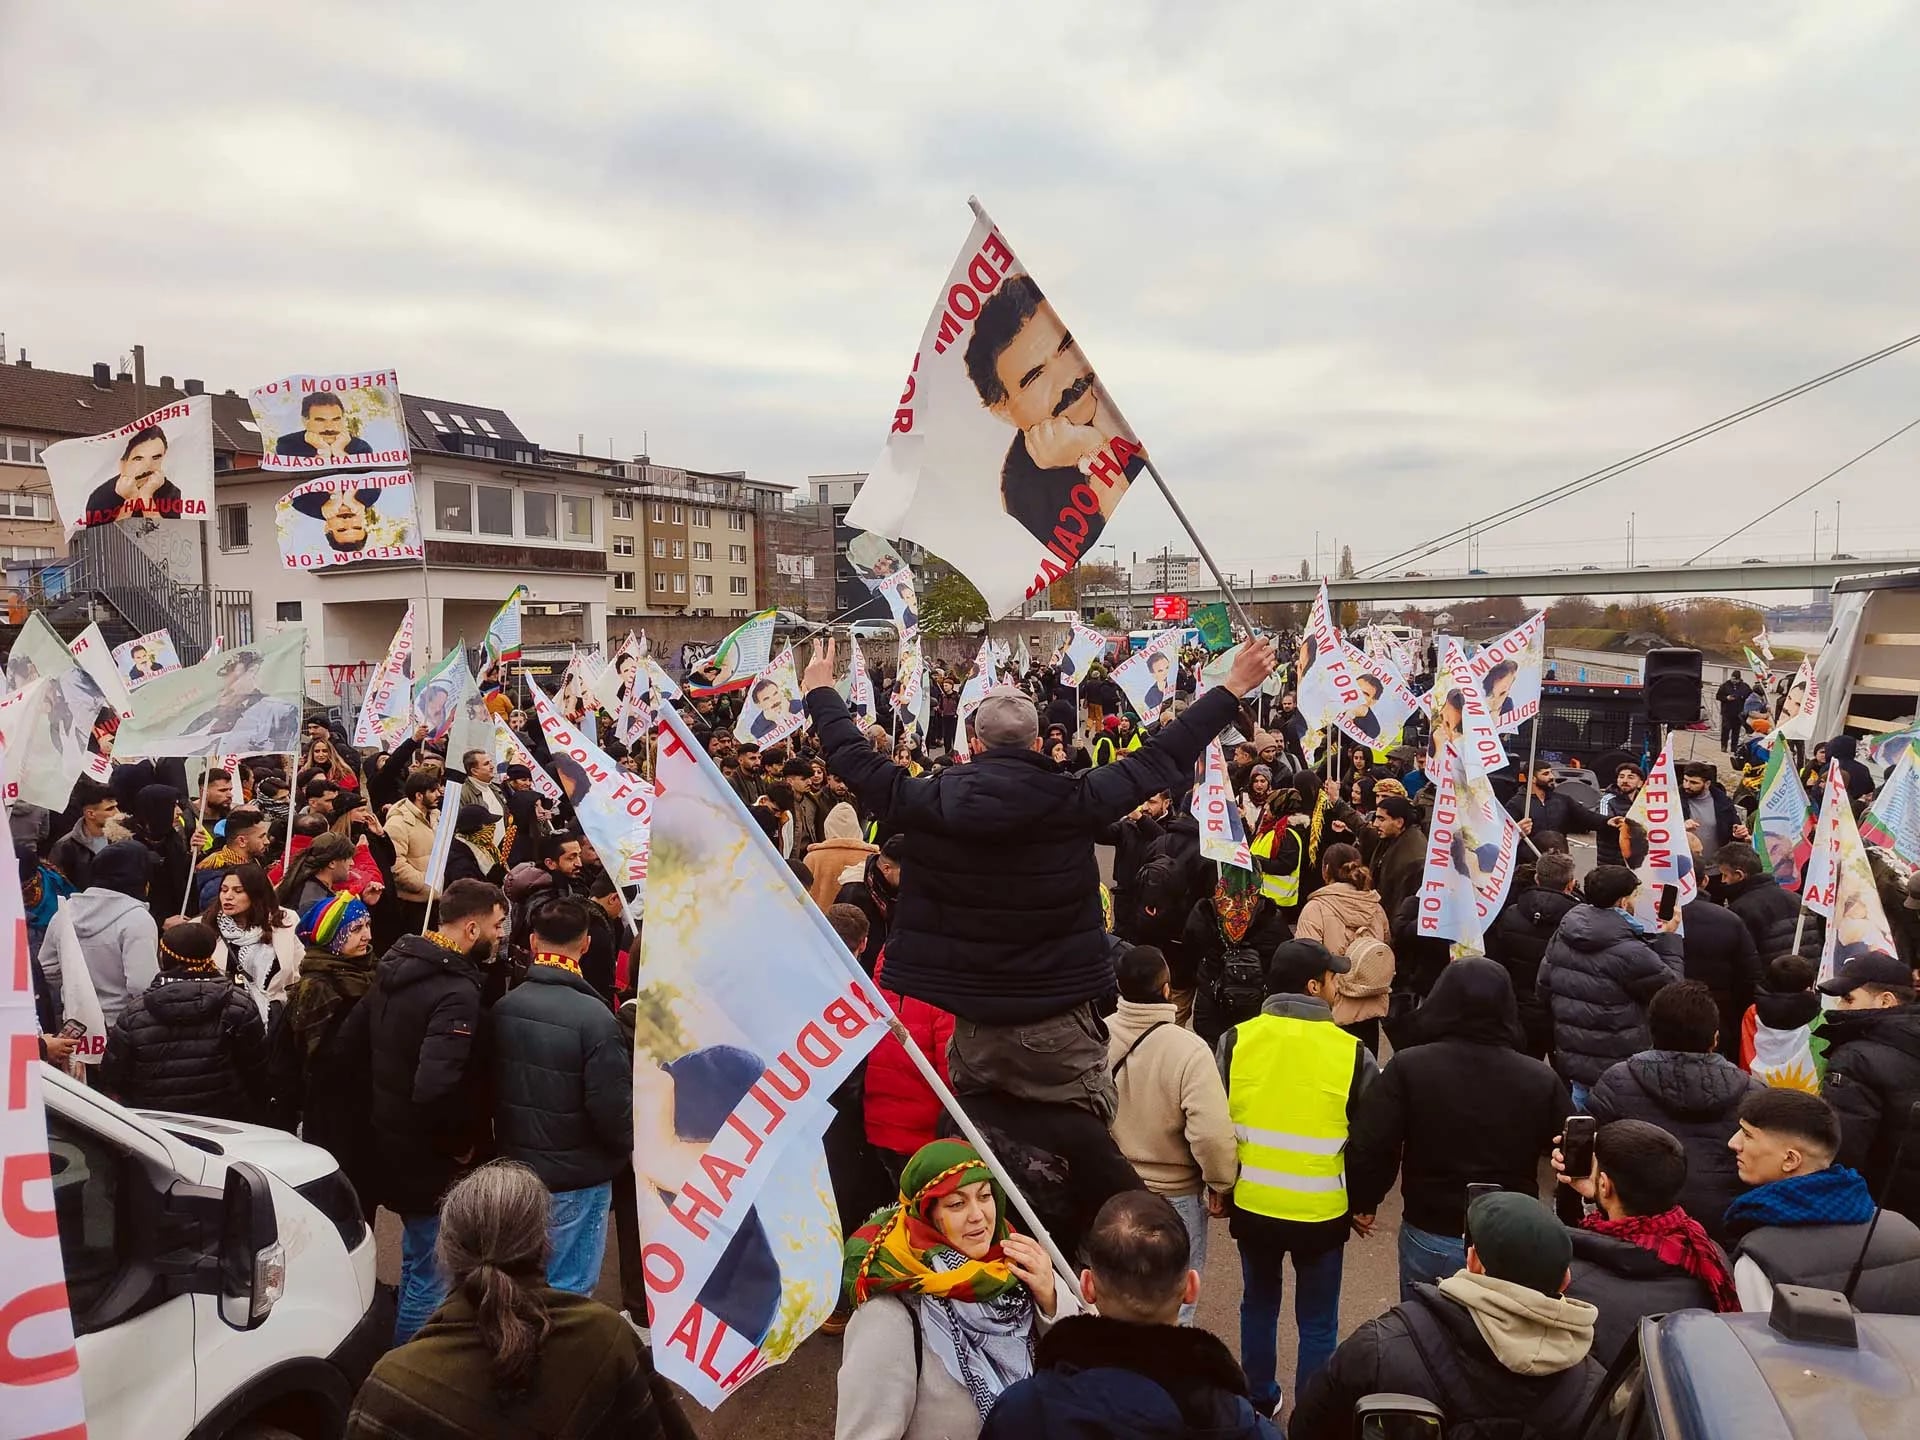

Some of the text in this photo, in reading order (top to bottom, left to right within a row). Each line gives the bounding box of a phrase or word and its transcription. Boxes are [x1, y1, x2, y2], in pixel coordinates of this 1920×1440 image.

[286, 553, 325, 568] FOR
[1327, 661, 1359, 703] FOR
[1394, 684, 1418, 710] FOR
[1472, 726, 1501, 767] FOR
